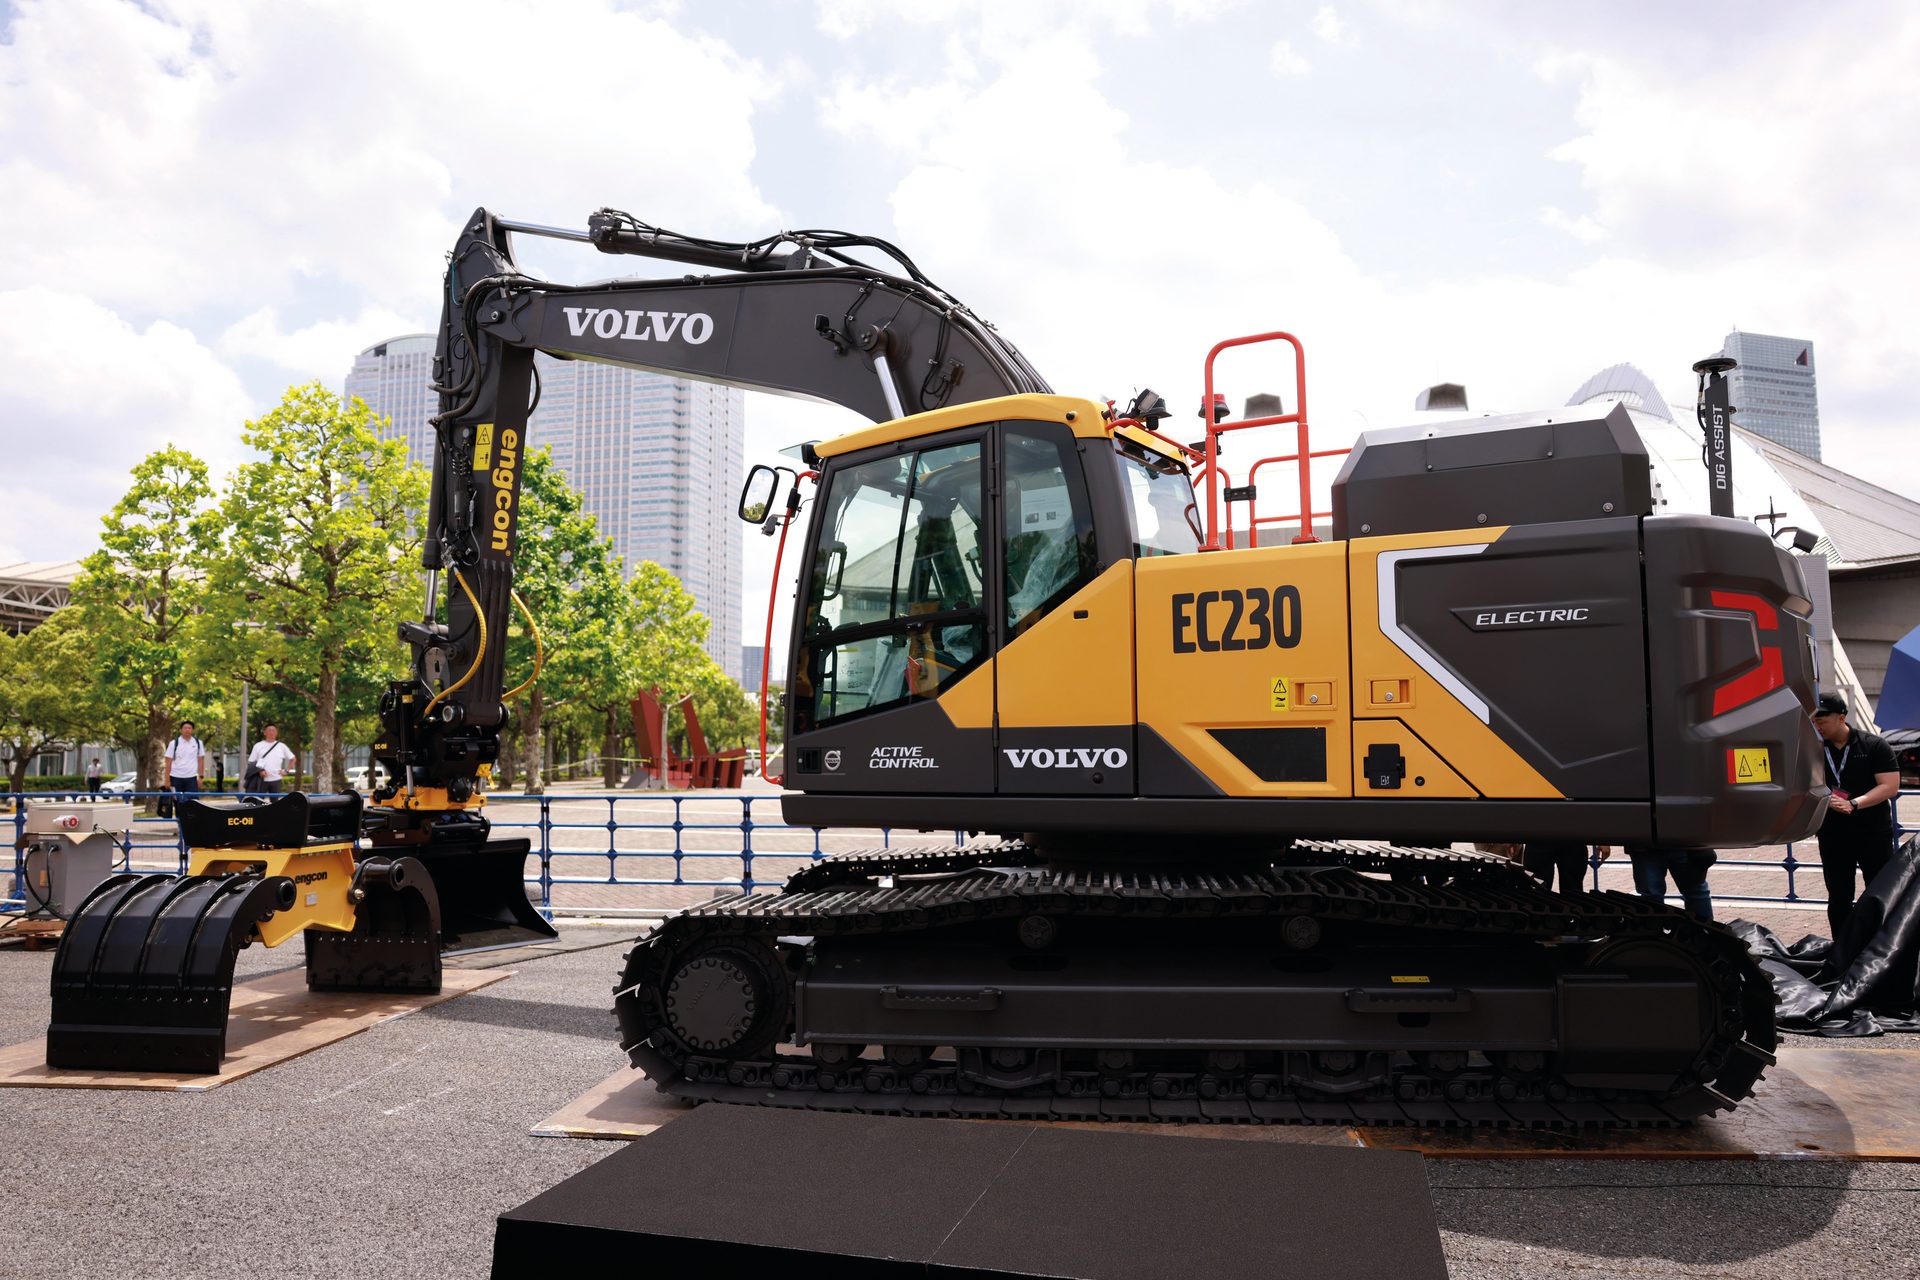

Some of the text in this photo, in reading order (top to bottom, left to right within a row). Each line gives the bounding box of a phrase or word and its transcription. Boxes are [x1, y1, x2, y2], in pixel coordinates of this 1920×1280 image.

[562, 306, 714, 345] VOLVO
[1712, 404, 1727, 490] DIG ASSIST
[491, 428, 518, 552] engcon
[1172, 584, 1302, 654] EC230
[1475, 608, 1589, 626] ELECTRIC
[870, 746, 923, 758] ACTIVE
[1002, 747, 1128, 769] VOLVO
[869, 758, 940, 769] CONTROL
[227, 817, 254, 826] EC-Oil
[294, 870, 328, 885] engcon
